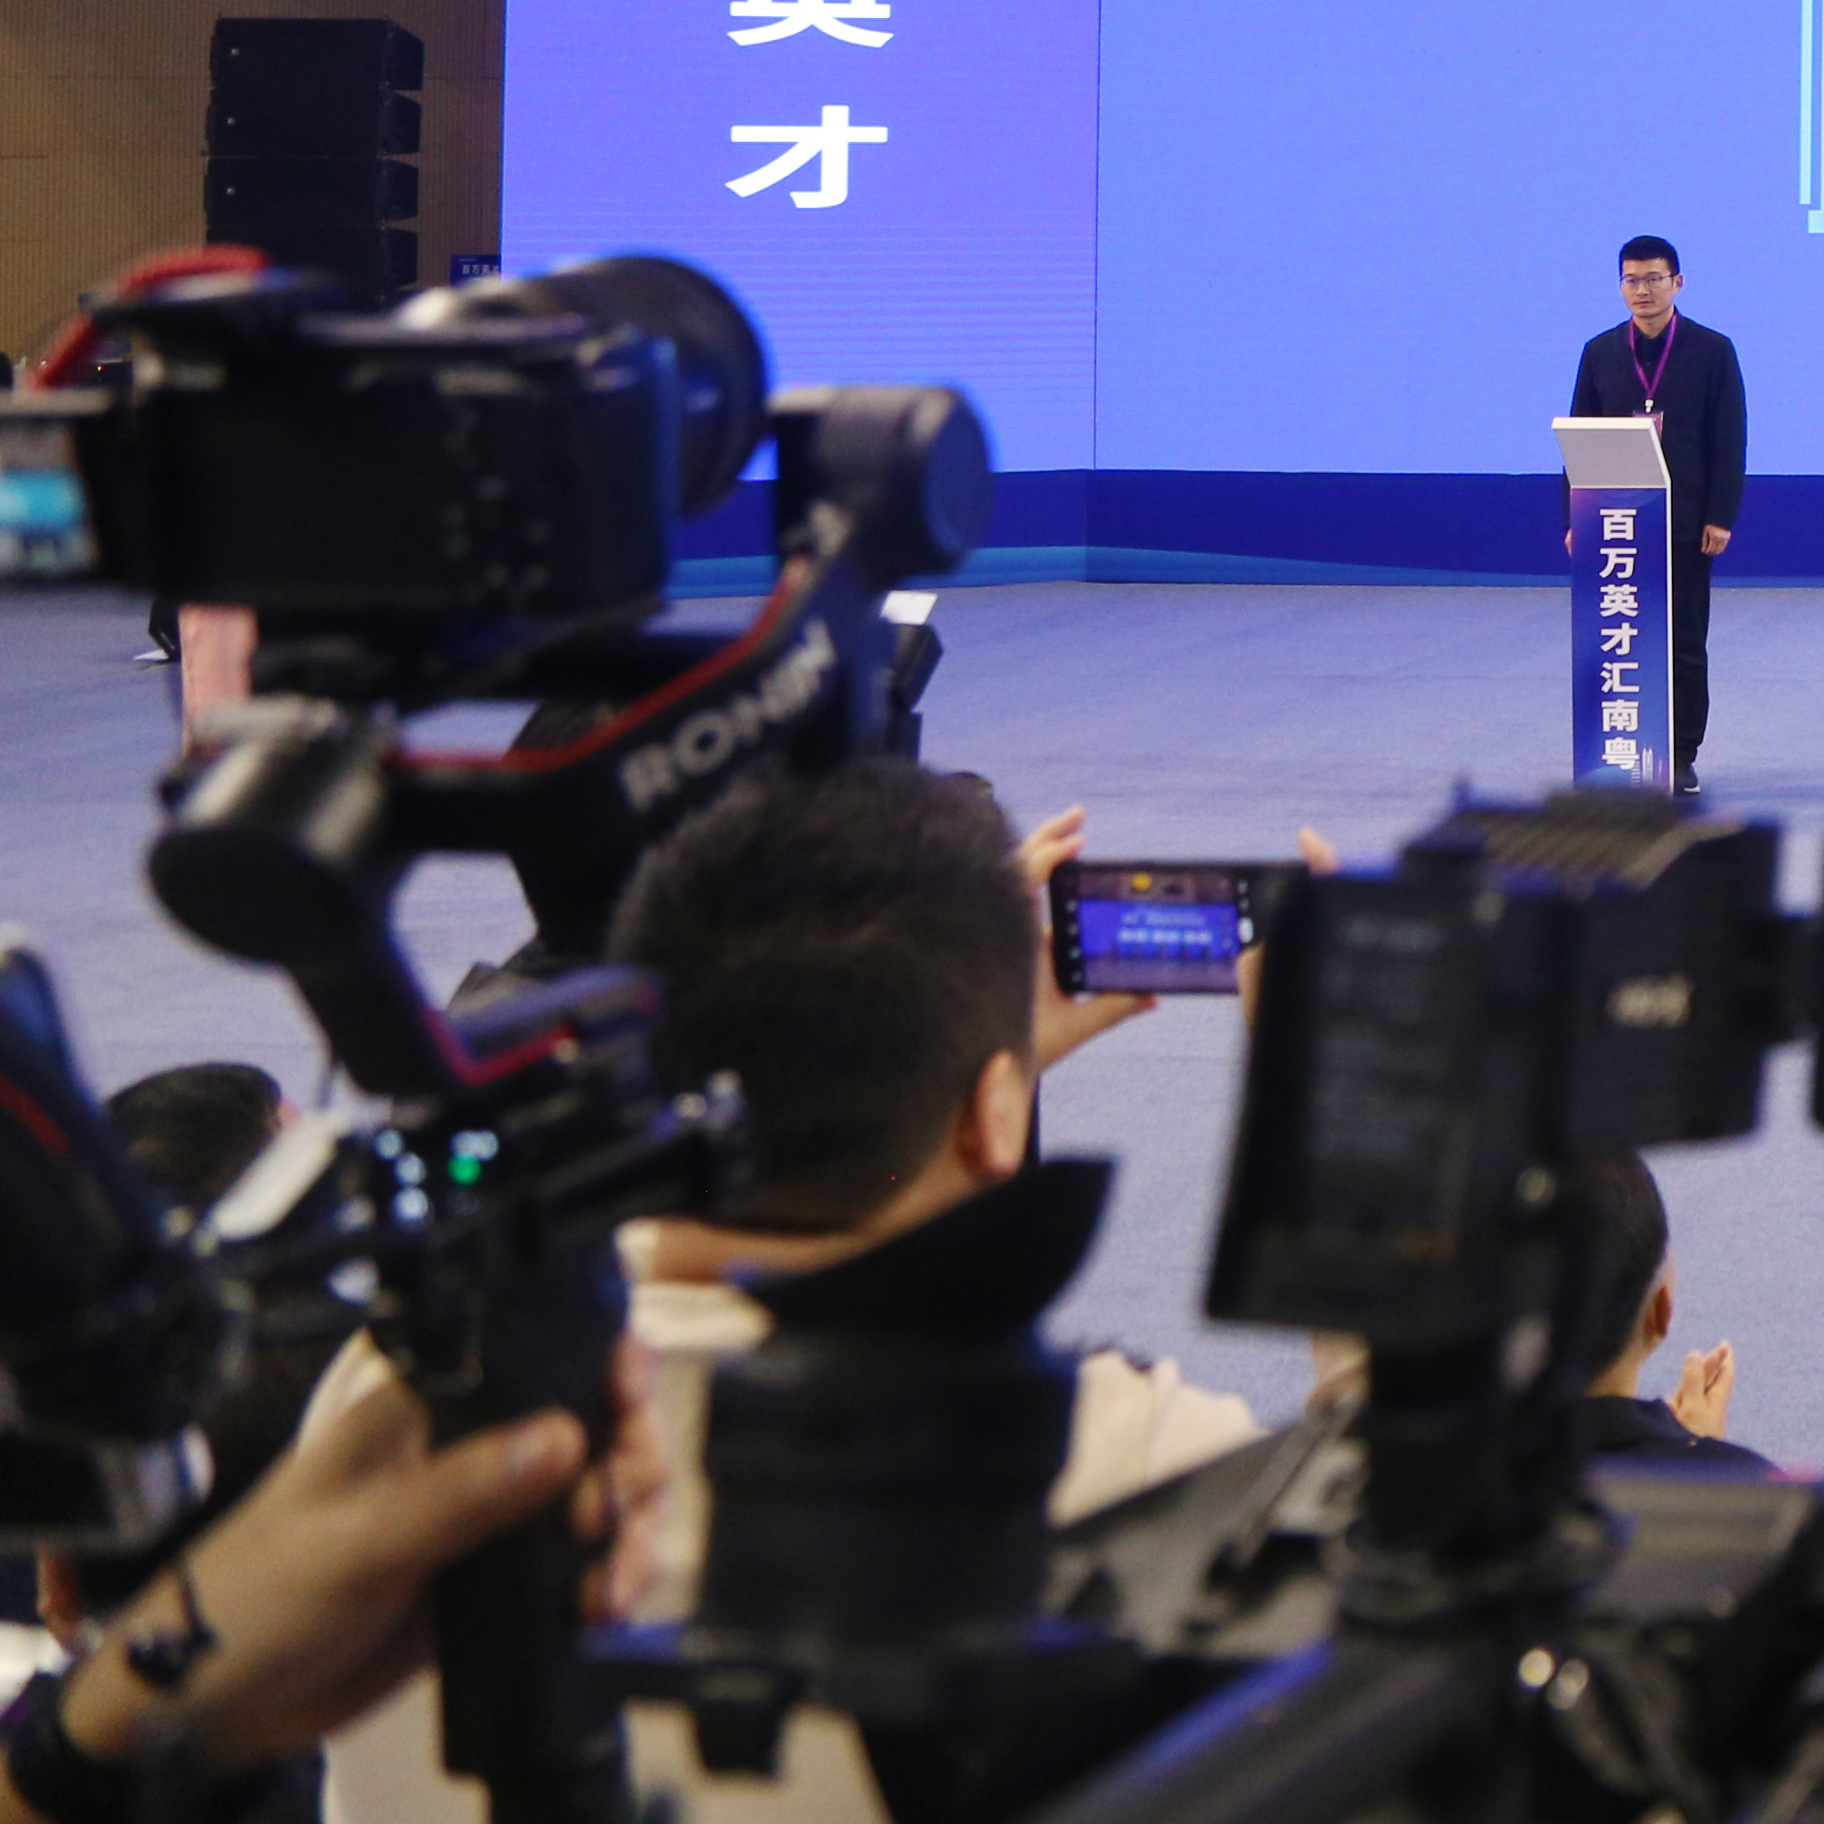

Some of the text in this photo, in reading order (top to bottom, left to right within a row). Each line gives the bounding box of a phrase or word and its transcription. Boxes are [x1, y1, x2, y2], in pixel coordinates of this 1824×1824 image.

[1599, 508, 1640, 771] 百万英才汇南粤
